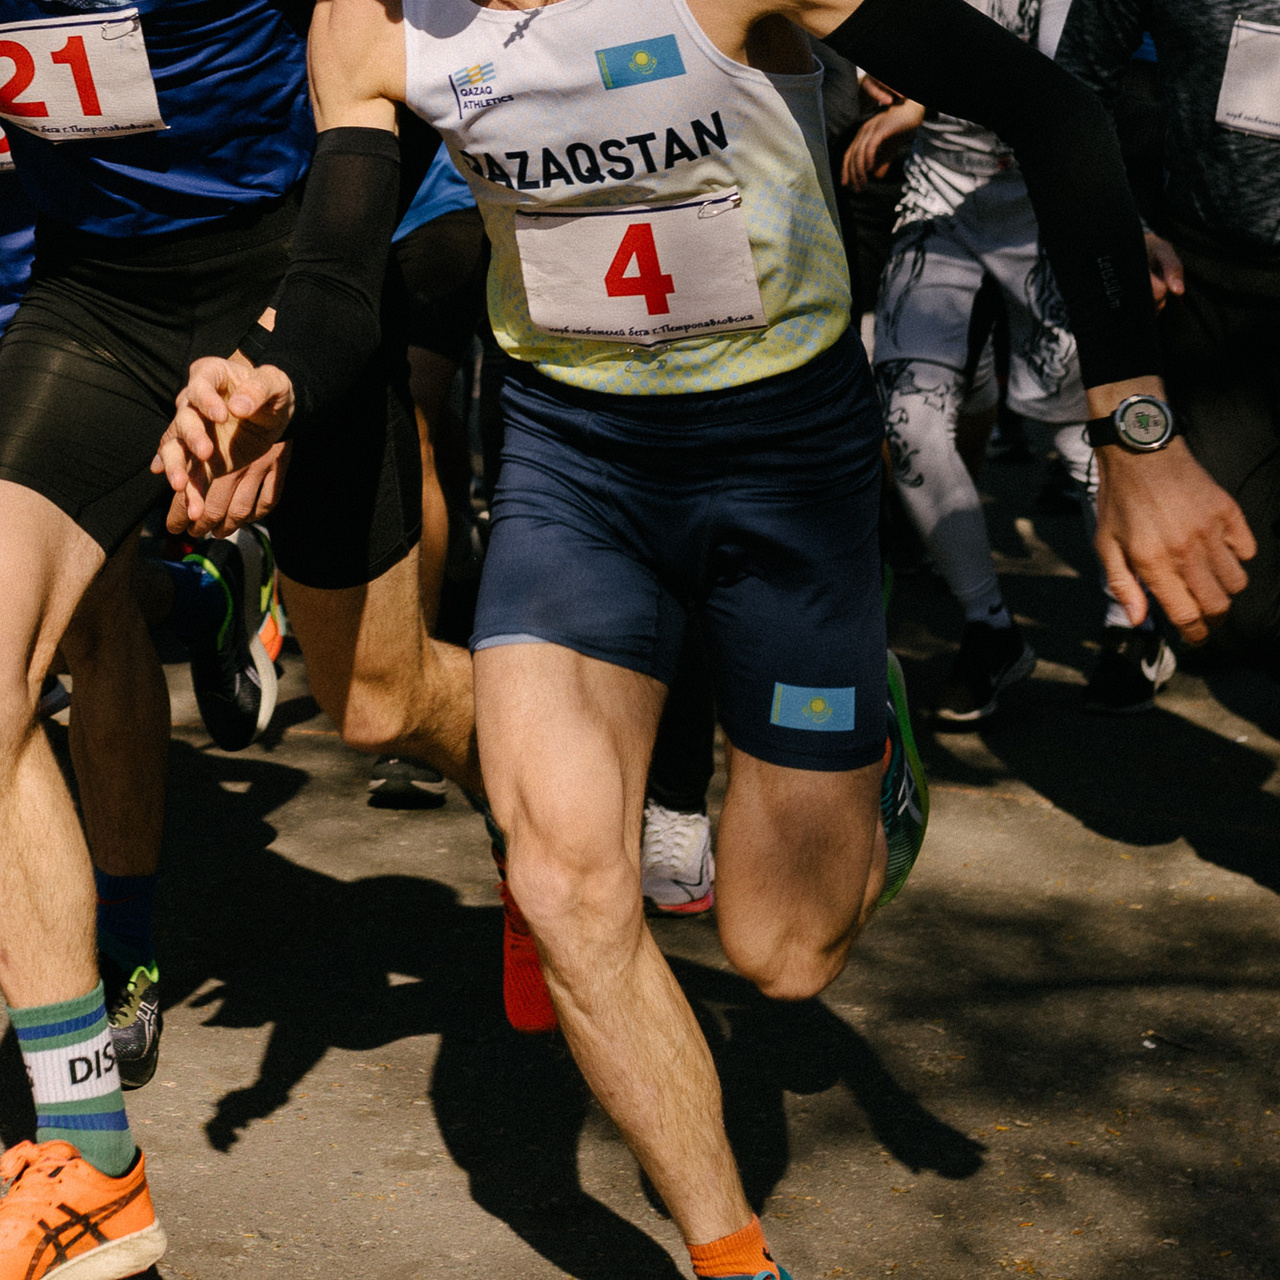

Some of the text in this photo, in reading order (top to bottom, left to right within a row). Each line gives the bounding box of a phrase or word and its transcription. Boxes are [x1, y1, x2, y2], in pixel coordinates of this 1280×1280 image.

[460, 85, 493, 97] QAZAQ
[463, 94, 515, 110] ATHLETICS
[604, 222, 675, 316] 4
